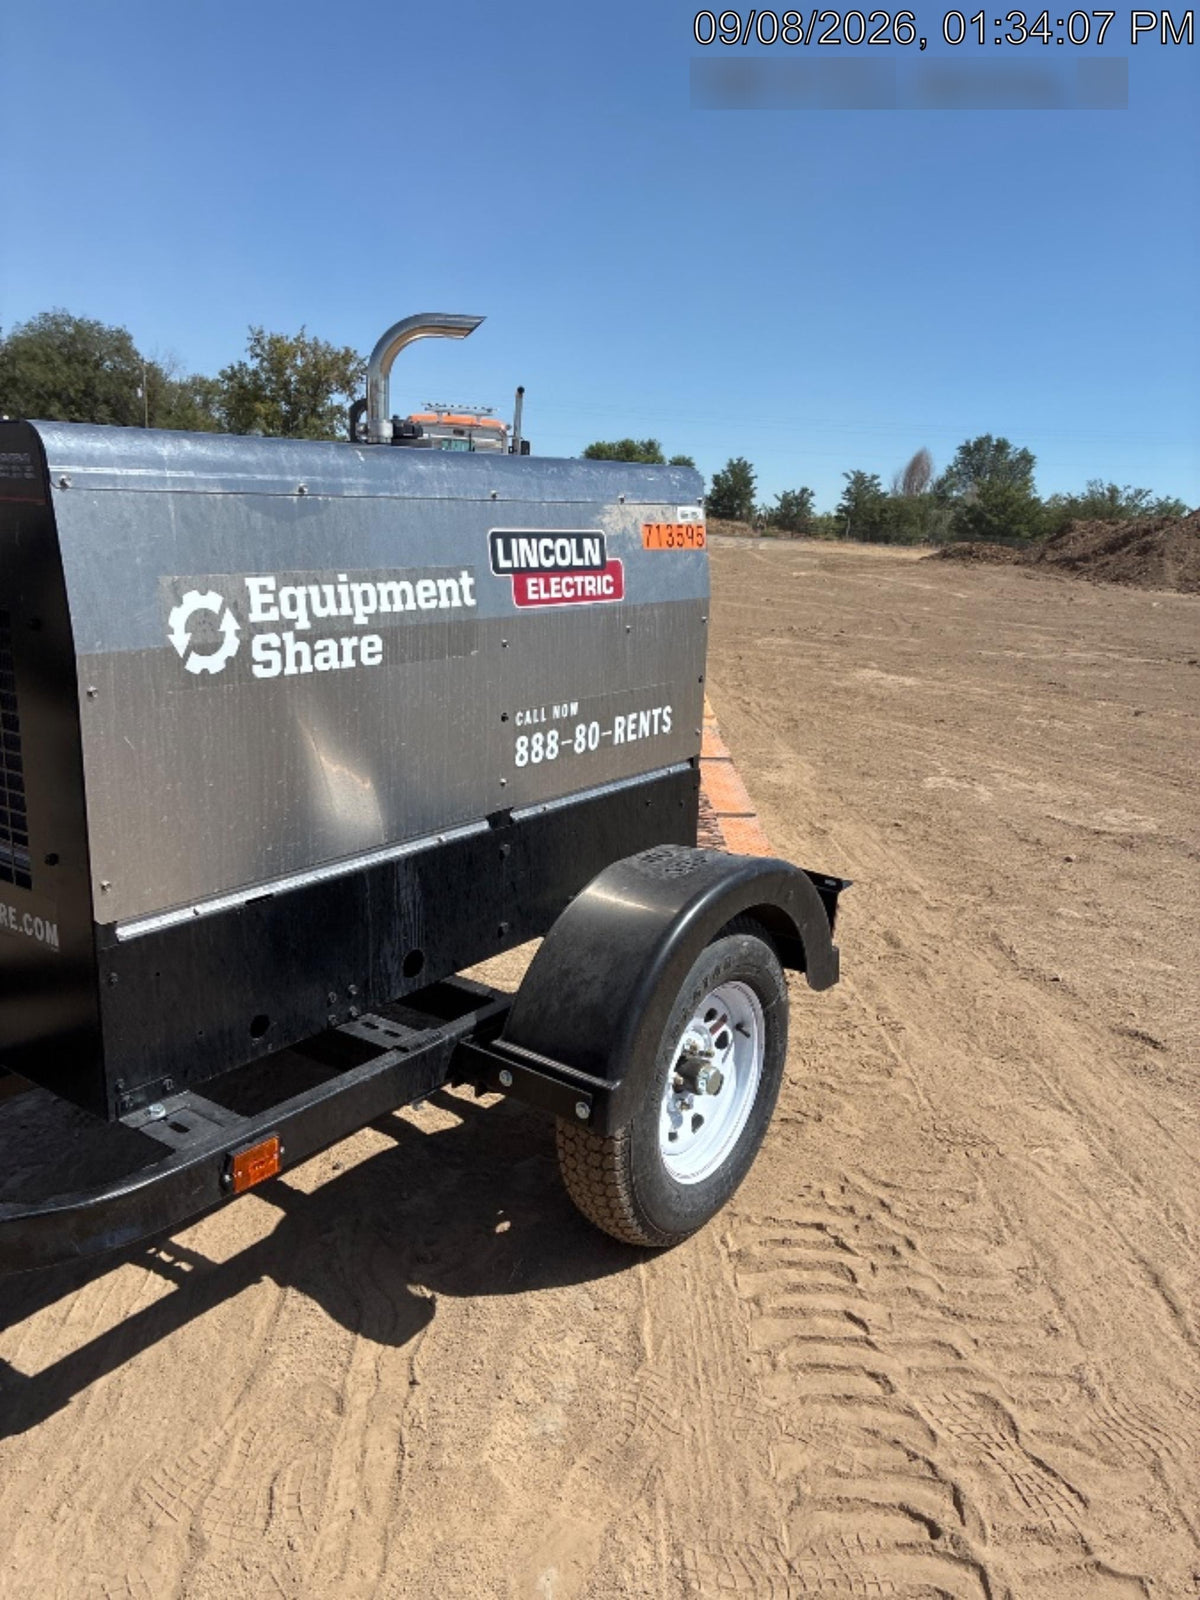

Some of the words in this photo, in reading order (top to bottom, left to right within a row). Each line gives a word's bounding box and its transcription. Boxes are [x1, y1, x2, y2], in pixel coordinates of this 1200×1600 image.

[643, 523, 705, 548] 713595
[495, 537, 601, 569] LINCOLN
[244, 570, 477, 630] Equipment
[526, 574, 615, 600] ELECTRIC
[251, 631, 384, 679] Share
[515, 706, 547, 726] CALL
[552, 701, 579, 720] NOW
[514, 705, 673, 767] 888-80-RENTS
